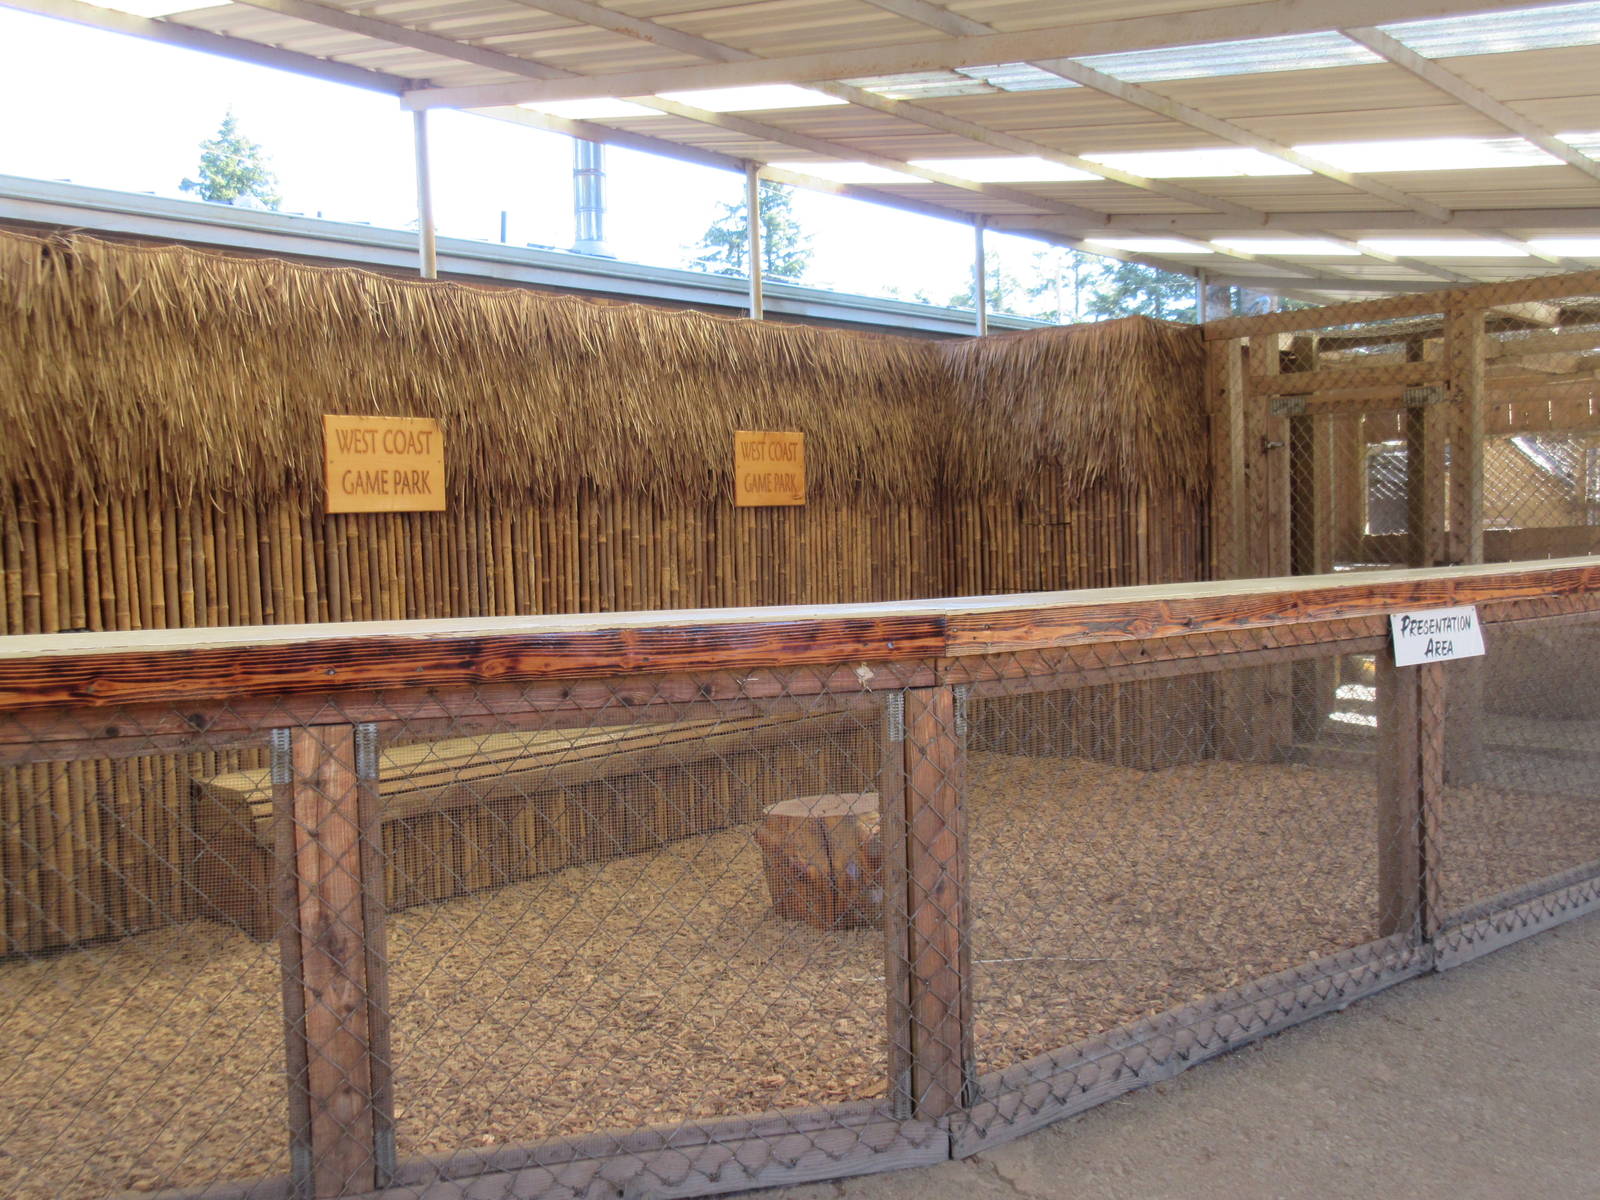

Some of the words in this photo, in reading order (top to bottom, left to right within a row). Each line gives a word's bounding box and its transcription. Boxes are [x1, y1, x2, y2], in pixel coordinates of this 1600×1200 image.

[335, 428, 378, 454] WEST
[383, 429, 433, 455] COAST
[741, 441, 766, 462] WEST
[768, 441, 798, 462] COAST
[341, 469, 389, 495] GAME
[394, 469, 432, 495] PARK
[744, 473, 772, 493] GAME
[774, 473, 797, 493] PARK
